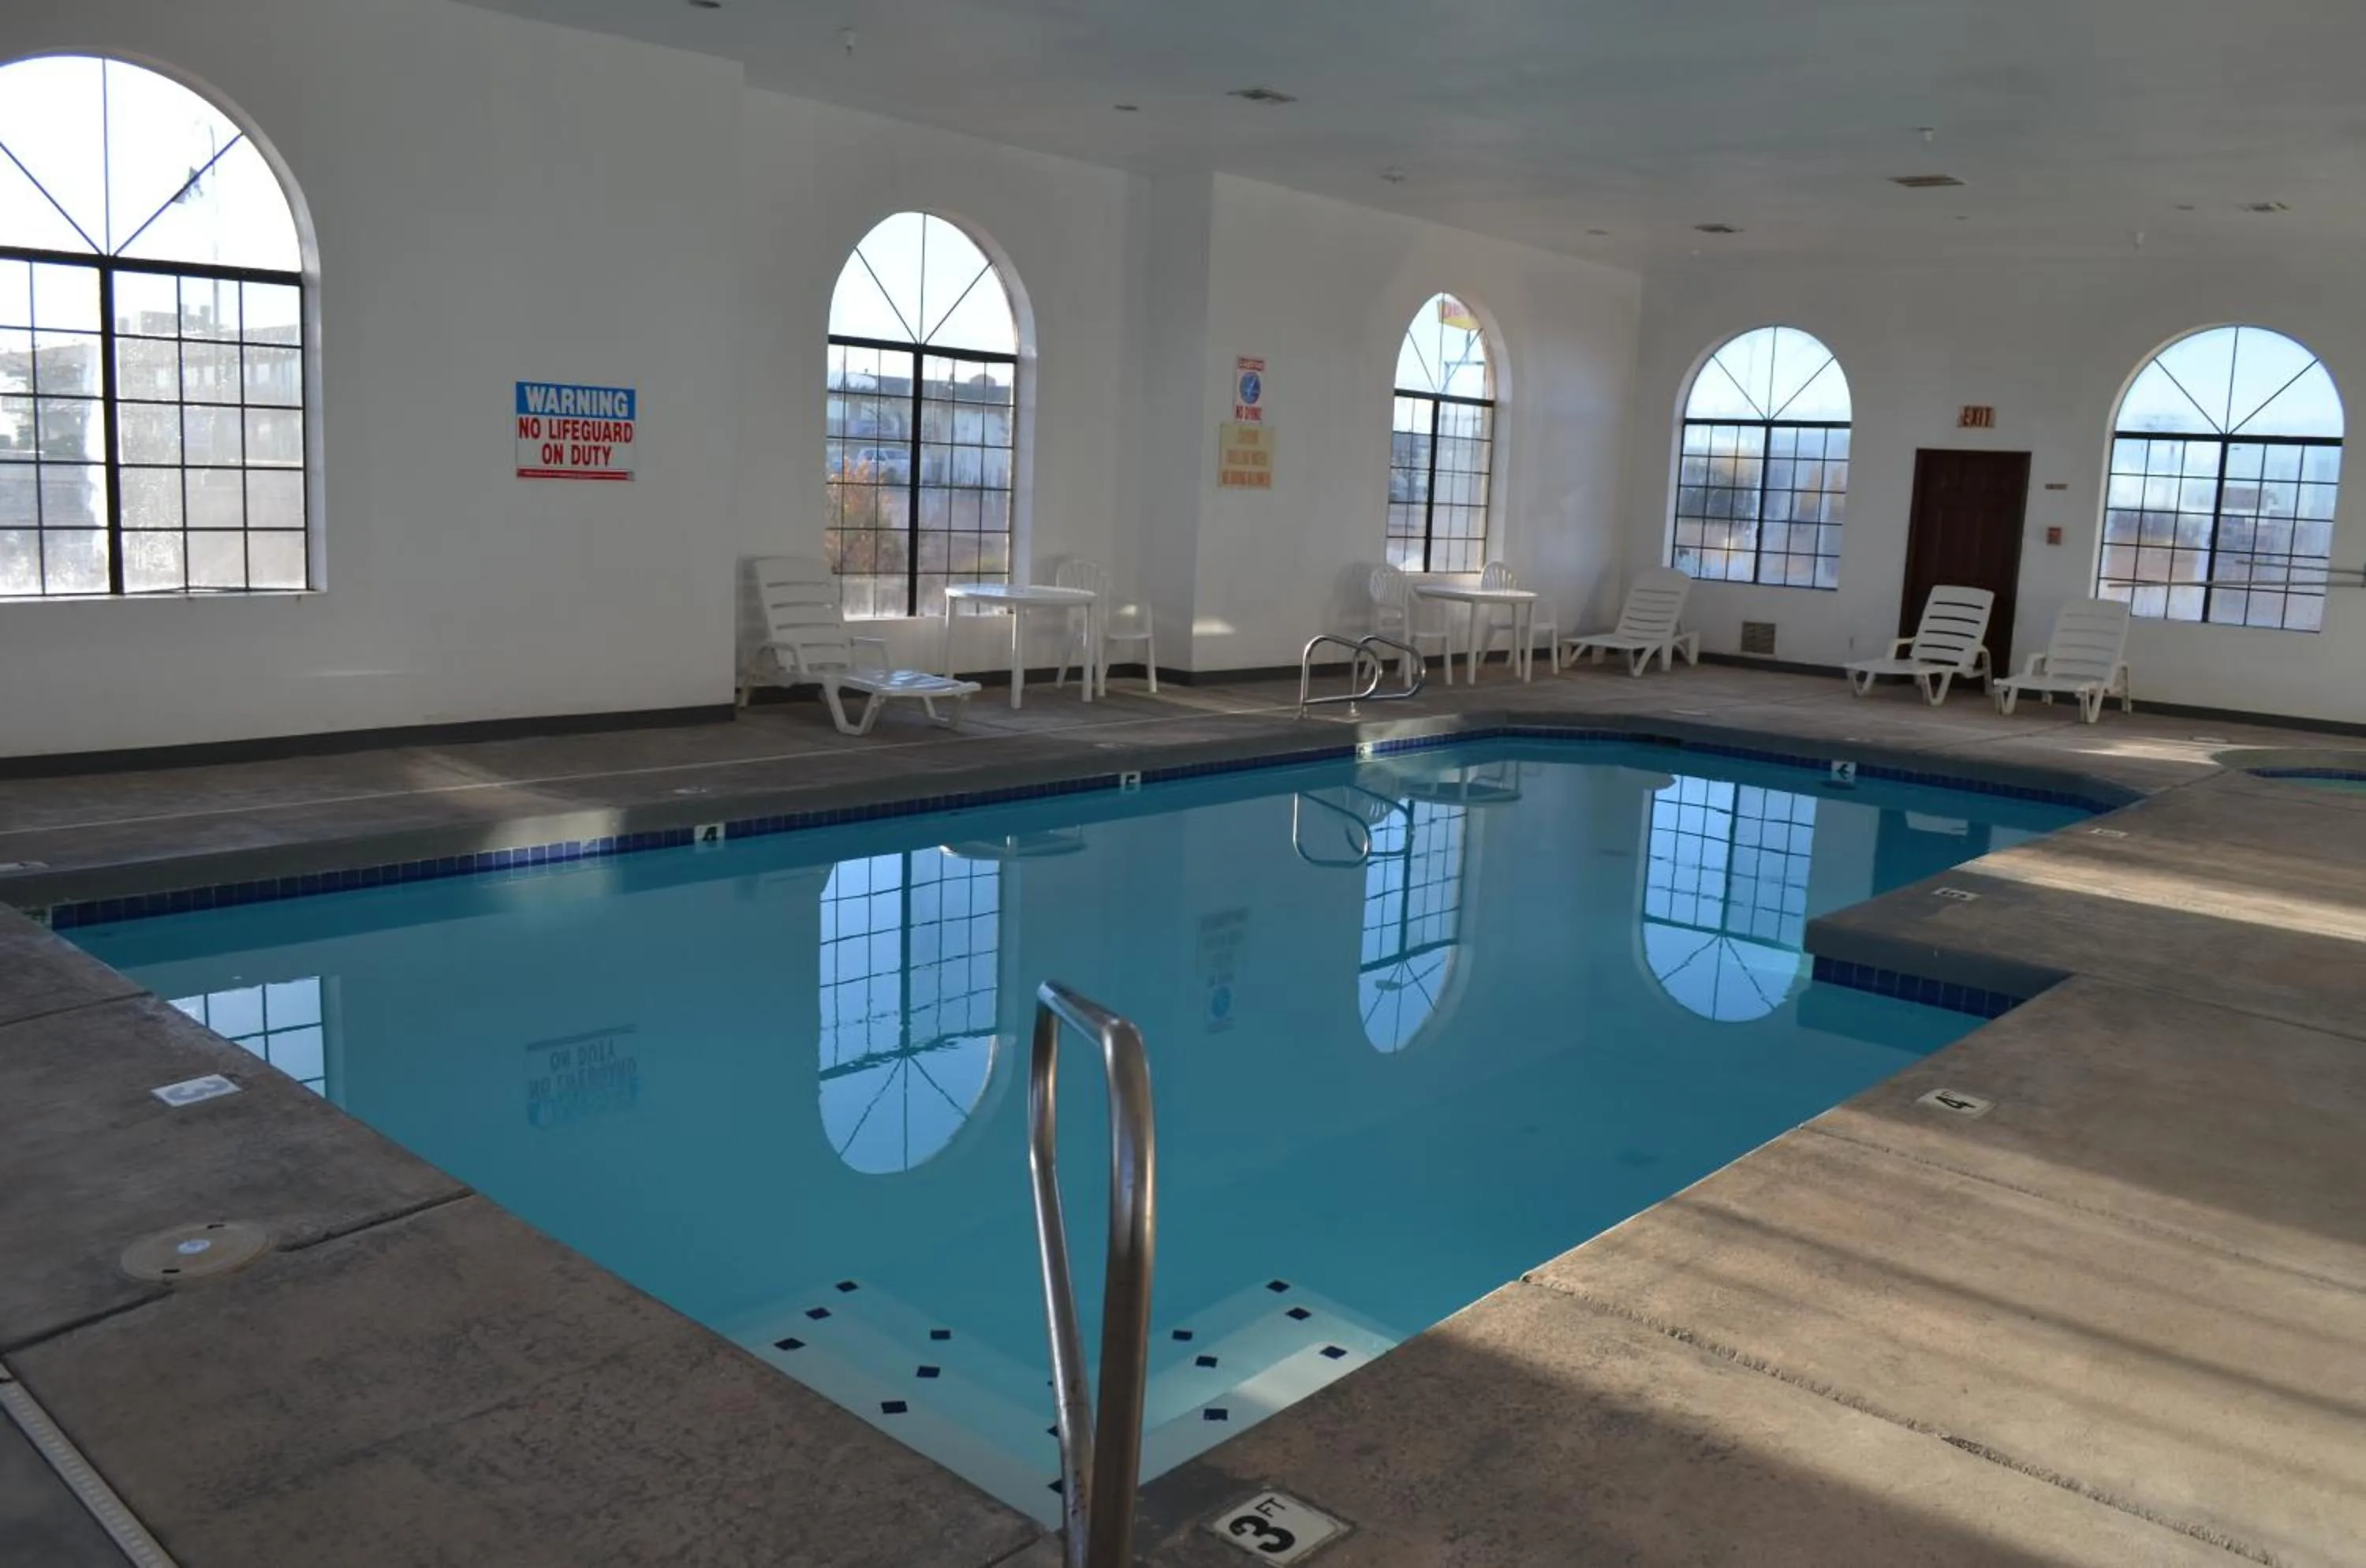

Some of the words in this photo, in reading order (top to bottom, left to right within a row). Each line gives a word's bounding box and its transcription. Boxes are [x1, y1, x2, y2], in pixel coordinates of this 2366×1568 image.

[524, 385, 629, 417] WARNING
[518, 416, 541, 439] NO
[548, 419, 633, 443] LIFEGUARD
[542, 443, 564, 465] ON
[571, 444, 612, 467] DUTY
[1255, 1497, 1286, 1519] FT
[1228, 1514, 1297, 1554] 3
